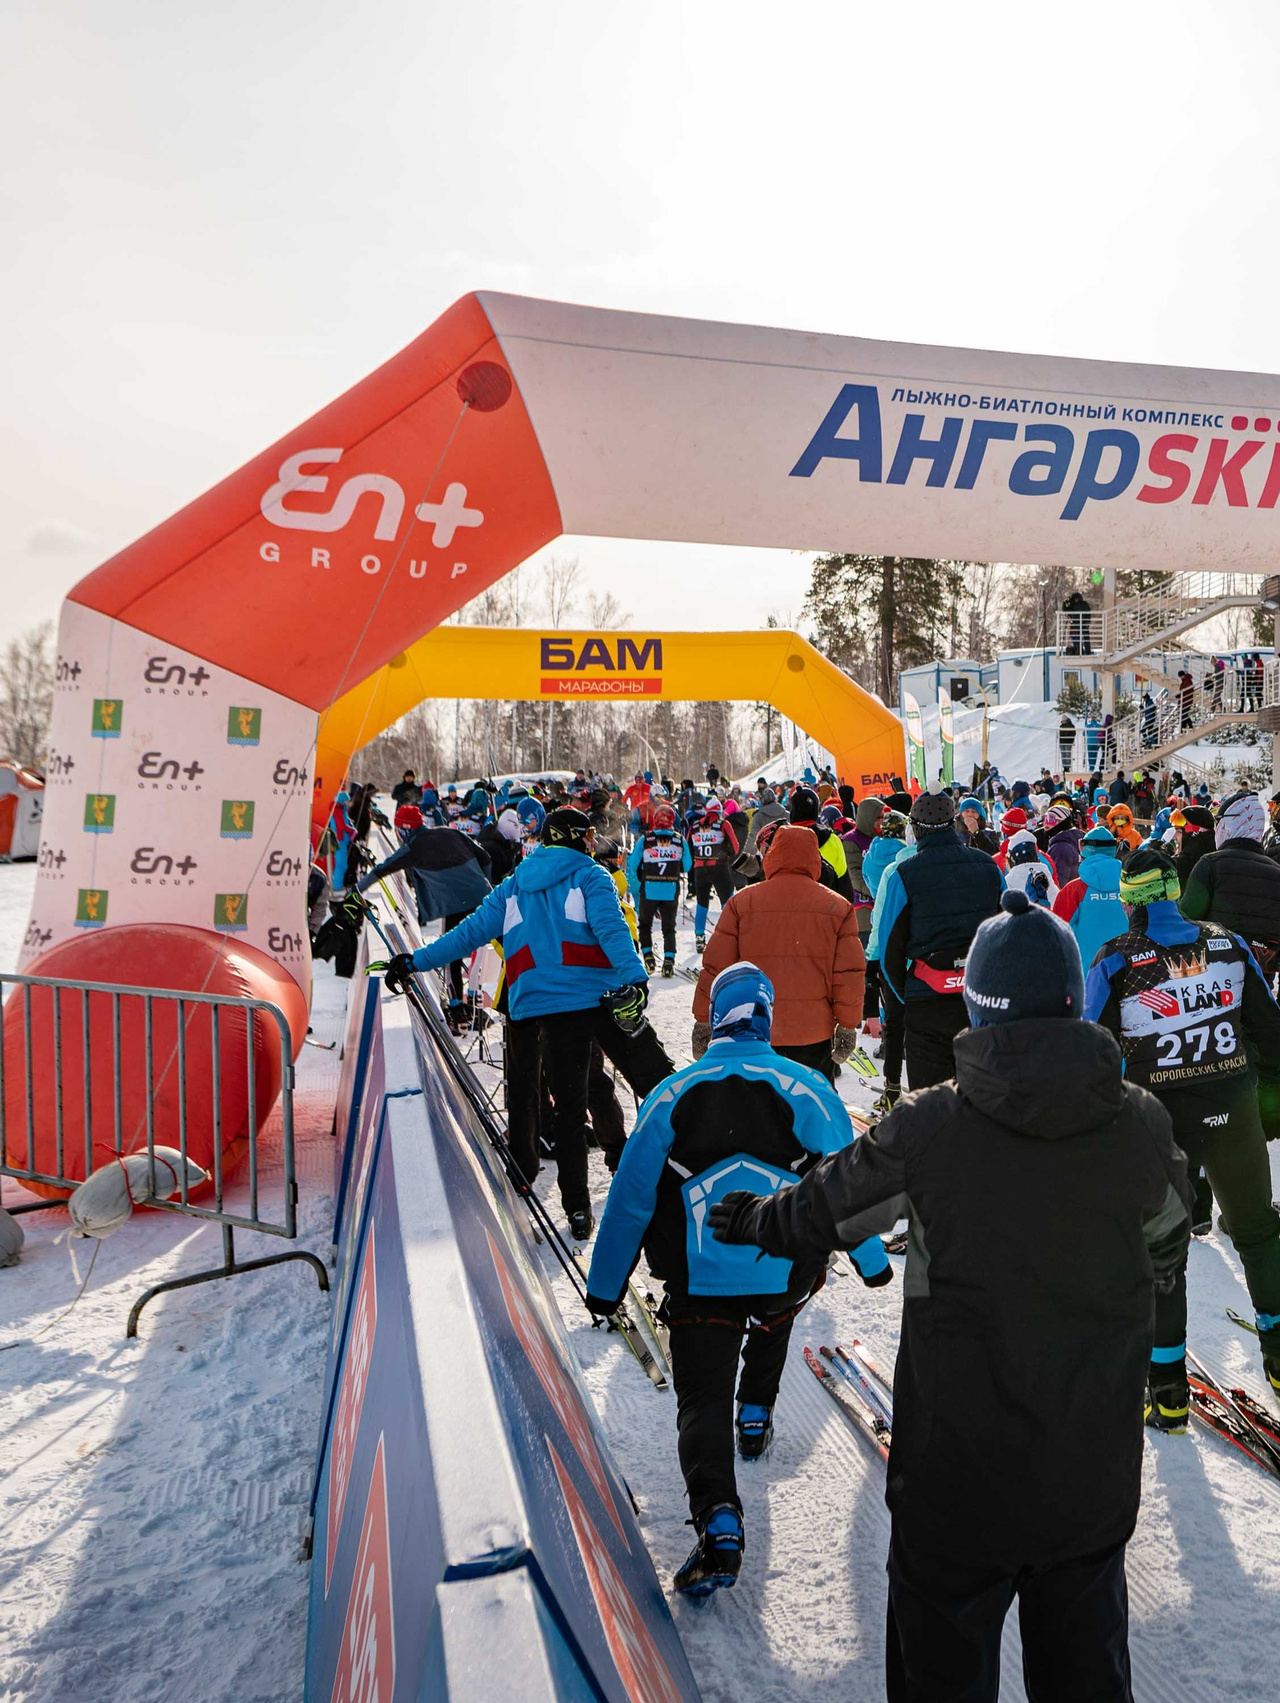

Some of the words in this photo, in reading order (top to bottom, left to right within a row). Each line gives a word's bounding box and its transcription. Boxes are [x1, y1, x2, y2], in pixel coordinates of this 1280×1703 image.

[891, 388, 1116, 421] ЛЫЖНО-БИАТЛОННЫЙ
[1121, 408, 1225, 429] КОМПЛЕКС
[259, 542, 468, 580] GROUP
[540, 638, 663, 671] БАМ
[144, 687, 208, 697] GROUP
[558, 680, 646, 693] МАРАФОНЫ
[138, 783, 202, 792] GROUP
[697, 846, 712, 857] 10
[658, 862, 667, 875] 7
[131, 878, 195, 887] GROUP
[1131, 950, 1157, 963] БАМ
[1180, 978, 1233, 996] KRAS
[1183, 990, 1234, 1013] LAND
[1155, 1021, 1238, 1067] 278
[1150, 1064, 1217, 1084] КОРОЛЕВСКИЕ
